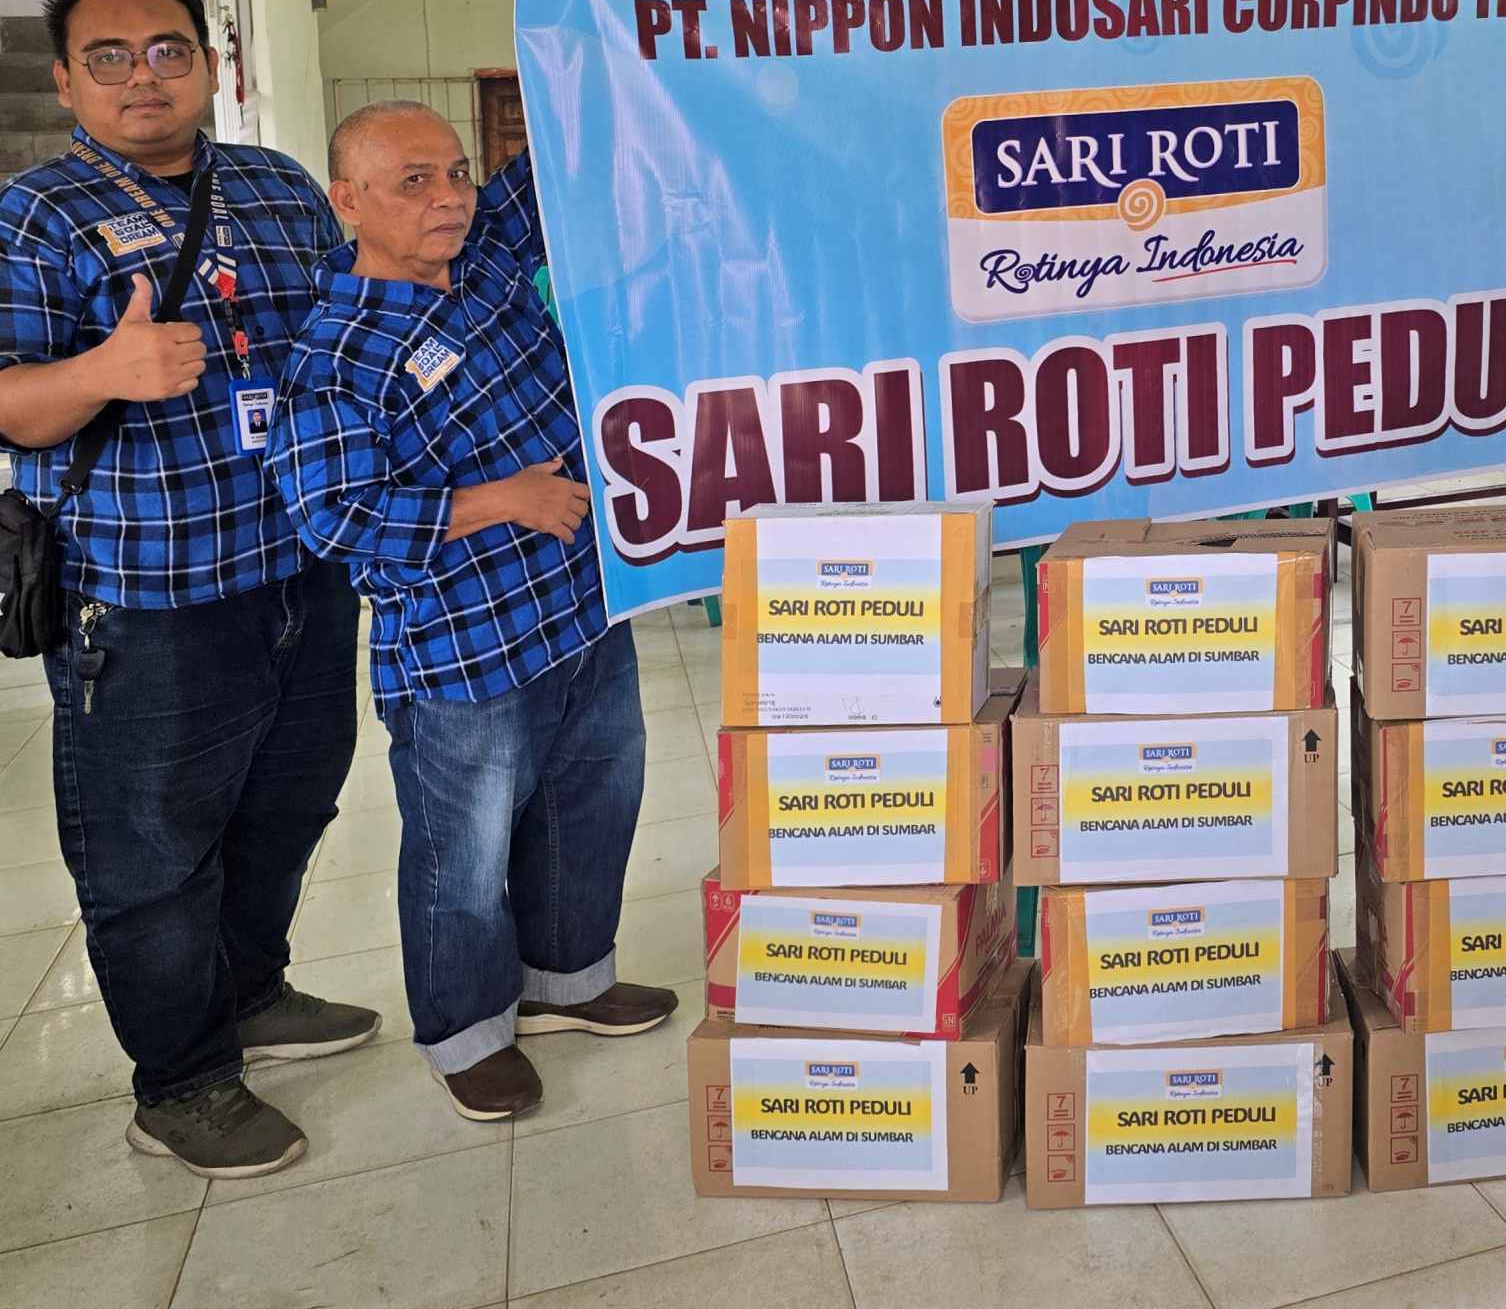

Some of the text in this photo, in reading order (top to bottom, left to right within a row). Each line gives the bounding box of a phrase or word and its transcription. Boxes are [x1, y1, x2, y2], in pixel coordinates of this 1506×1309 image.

[995, 119, 1281, 189] SARI ROTI
[210, 194, 229, 220] GOAL
[109, 216, 146, 231] TEAM
[115, 222, 152, 237] GOAL
[120, 228, 160, 244] DREAM
[980, 229, 1304, 300] Rotinya Indonesia
[597, 361, 922, 555] SARI
[946, 327, 1226, 499] ROTI
[768, 599, 923, 616] SARI ROTI PEDULI
[1459, 618, 1502, 635] SARI
[756, 632, 924, 645] BENCANA ALAM DI SUMBAR
[1304, 753, 1320, 763] UP
[1091, 781, 1250, 802] SARI ROTI PEDULI
[1080, 814, 1252, 831] BENCANA ALAM DI SUMBAR
[963, 1085, 979, 1095] UP
[1458, 1085, 1497, 1104] SARI
[1447, 1116, 1505, 1133] BENCANA
